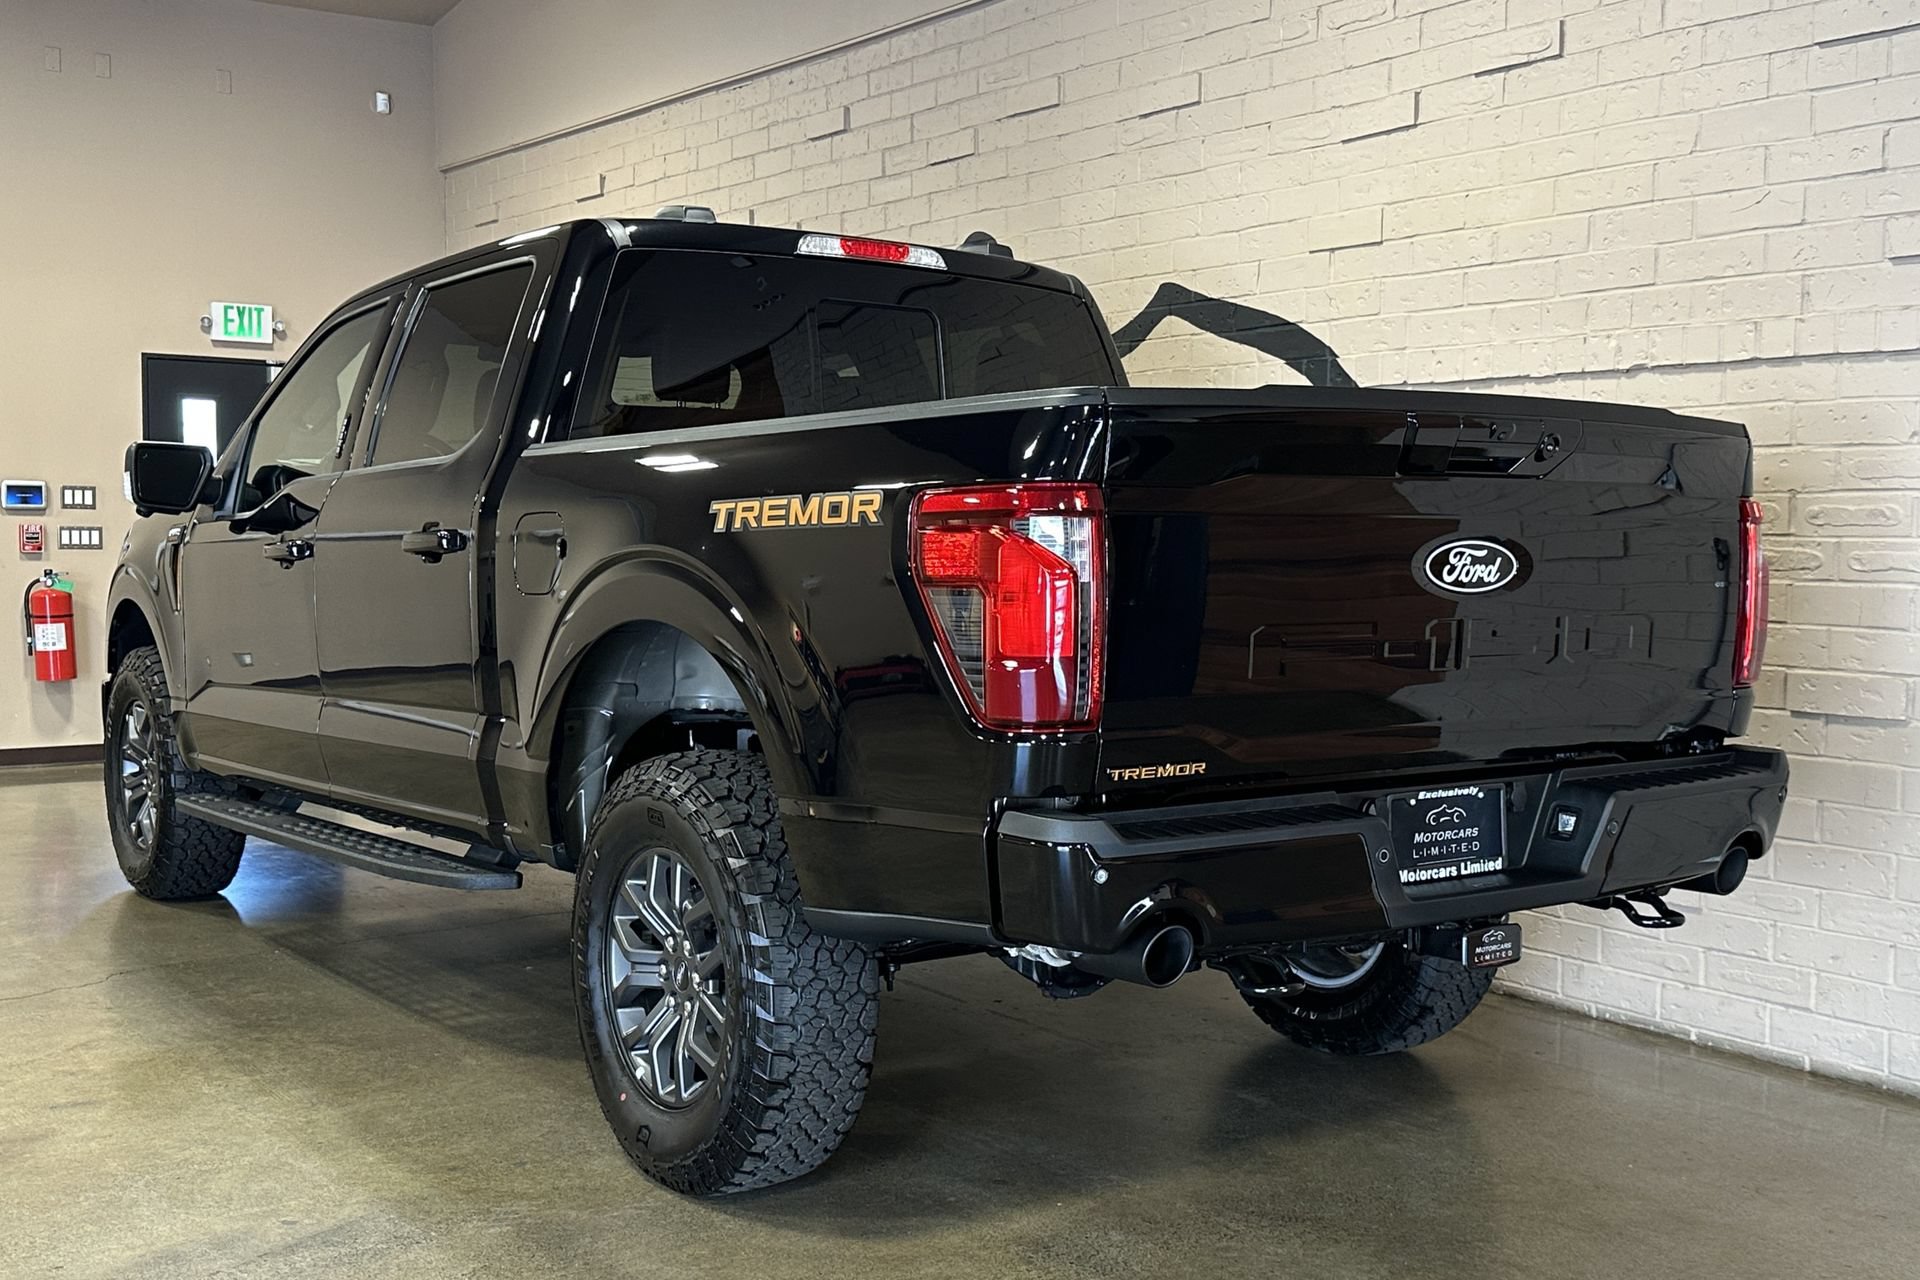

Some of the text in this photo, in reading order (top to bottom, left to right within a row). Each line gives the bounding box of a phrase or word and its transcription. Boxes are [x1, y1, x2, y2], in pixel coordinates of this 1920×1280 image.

[223, 304, 265, 338] EXIT
[709, 489, 885, 533] TREMOR
[1442, 547, 1502, 583] Ford
[1106, 762, 1207, 781] TREMOR
[1417, 786, 1480, 800] Exclusively
[1413, 827, 1480, 844] MOTORCARS
[1399, 857, 1503, 883] Motorcars Limited
[1475, 942, 1512, 954] MOTORCARS
